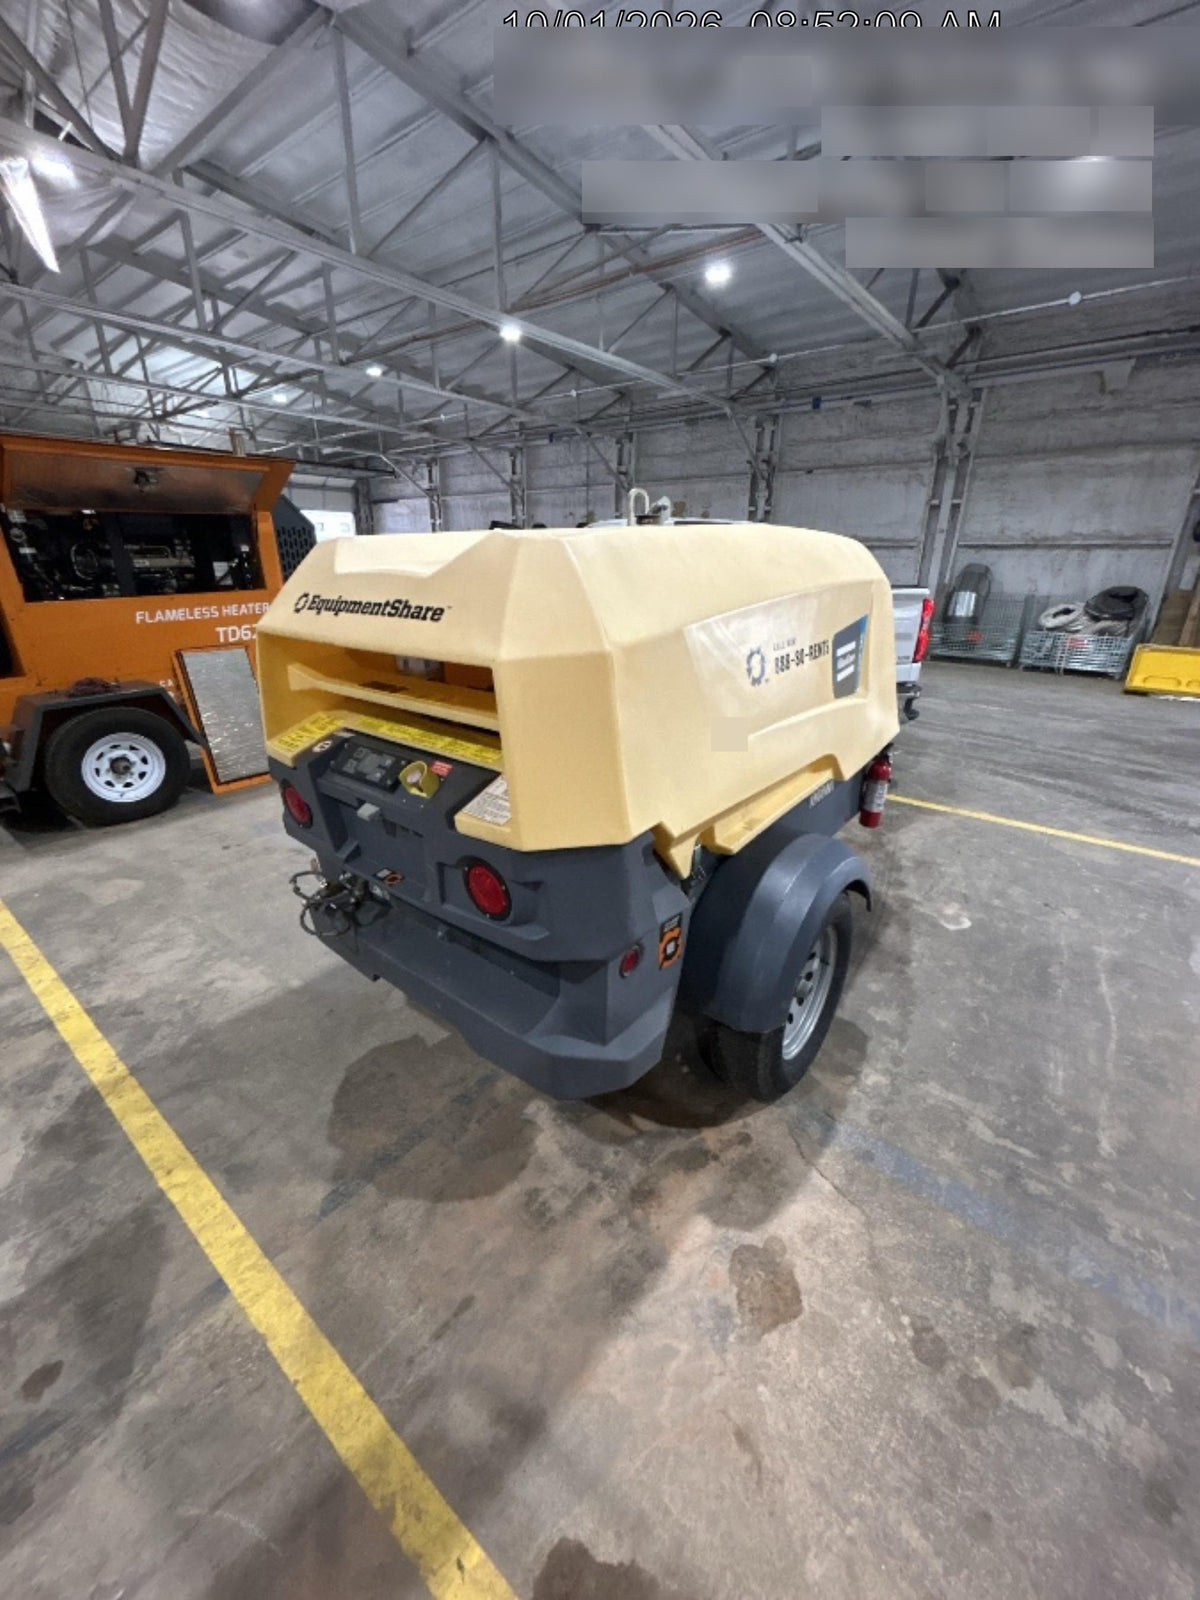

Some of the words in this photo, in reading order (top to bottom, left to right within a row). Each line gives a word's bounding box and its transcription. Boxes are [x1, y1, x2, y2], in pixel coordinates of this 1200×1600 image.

[135, 606, 219, 624] FLAMELESS
[222, 602, 270, 616] HEATER
[307, 594, 445, 622] EquipmentShare
